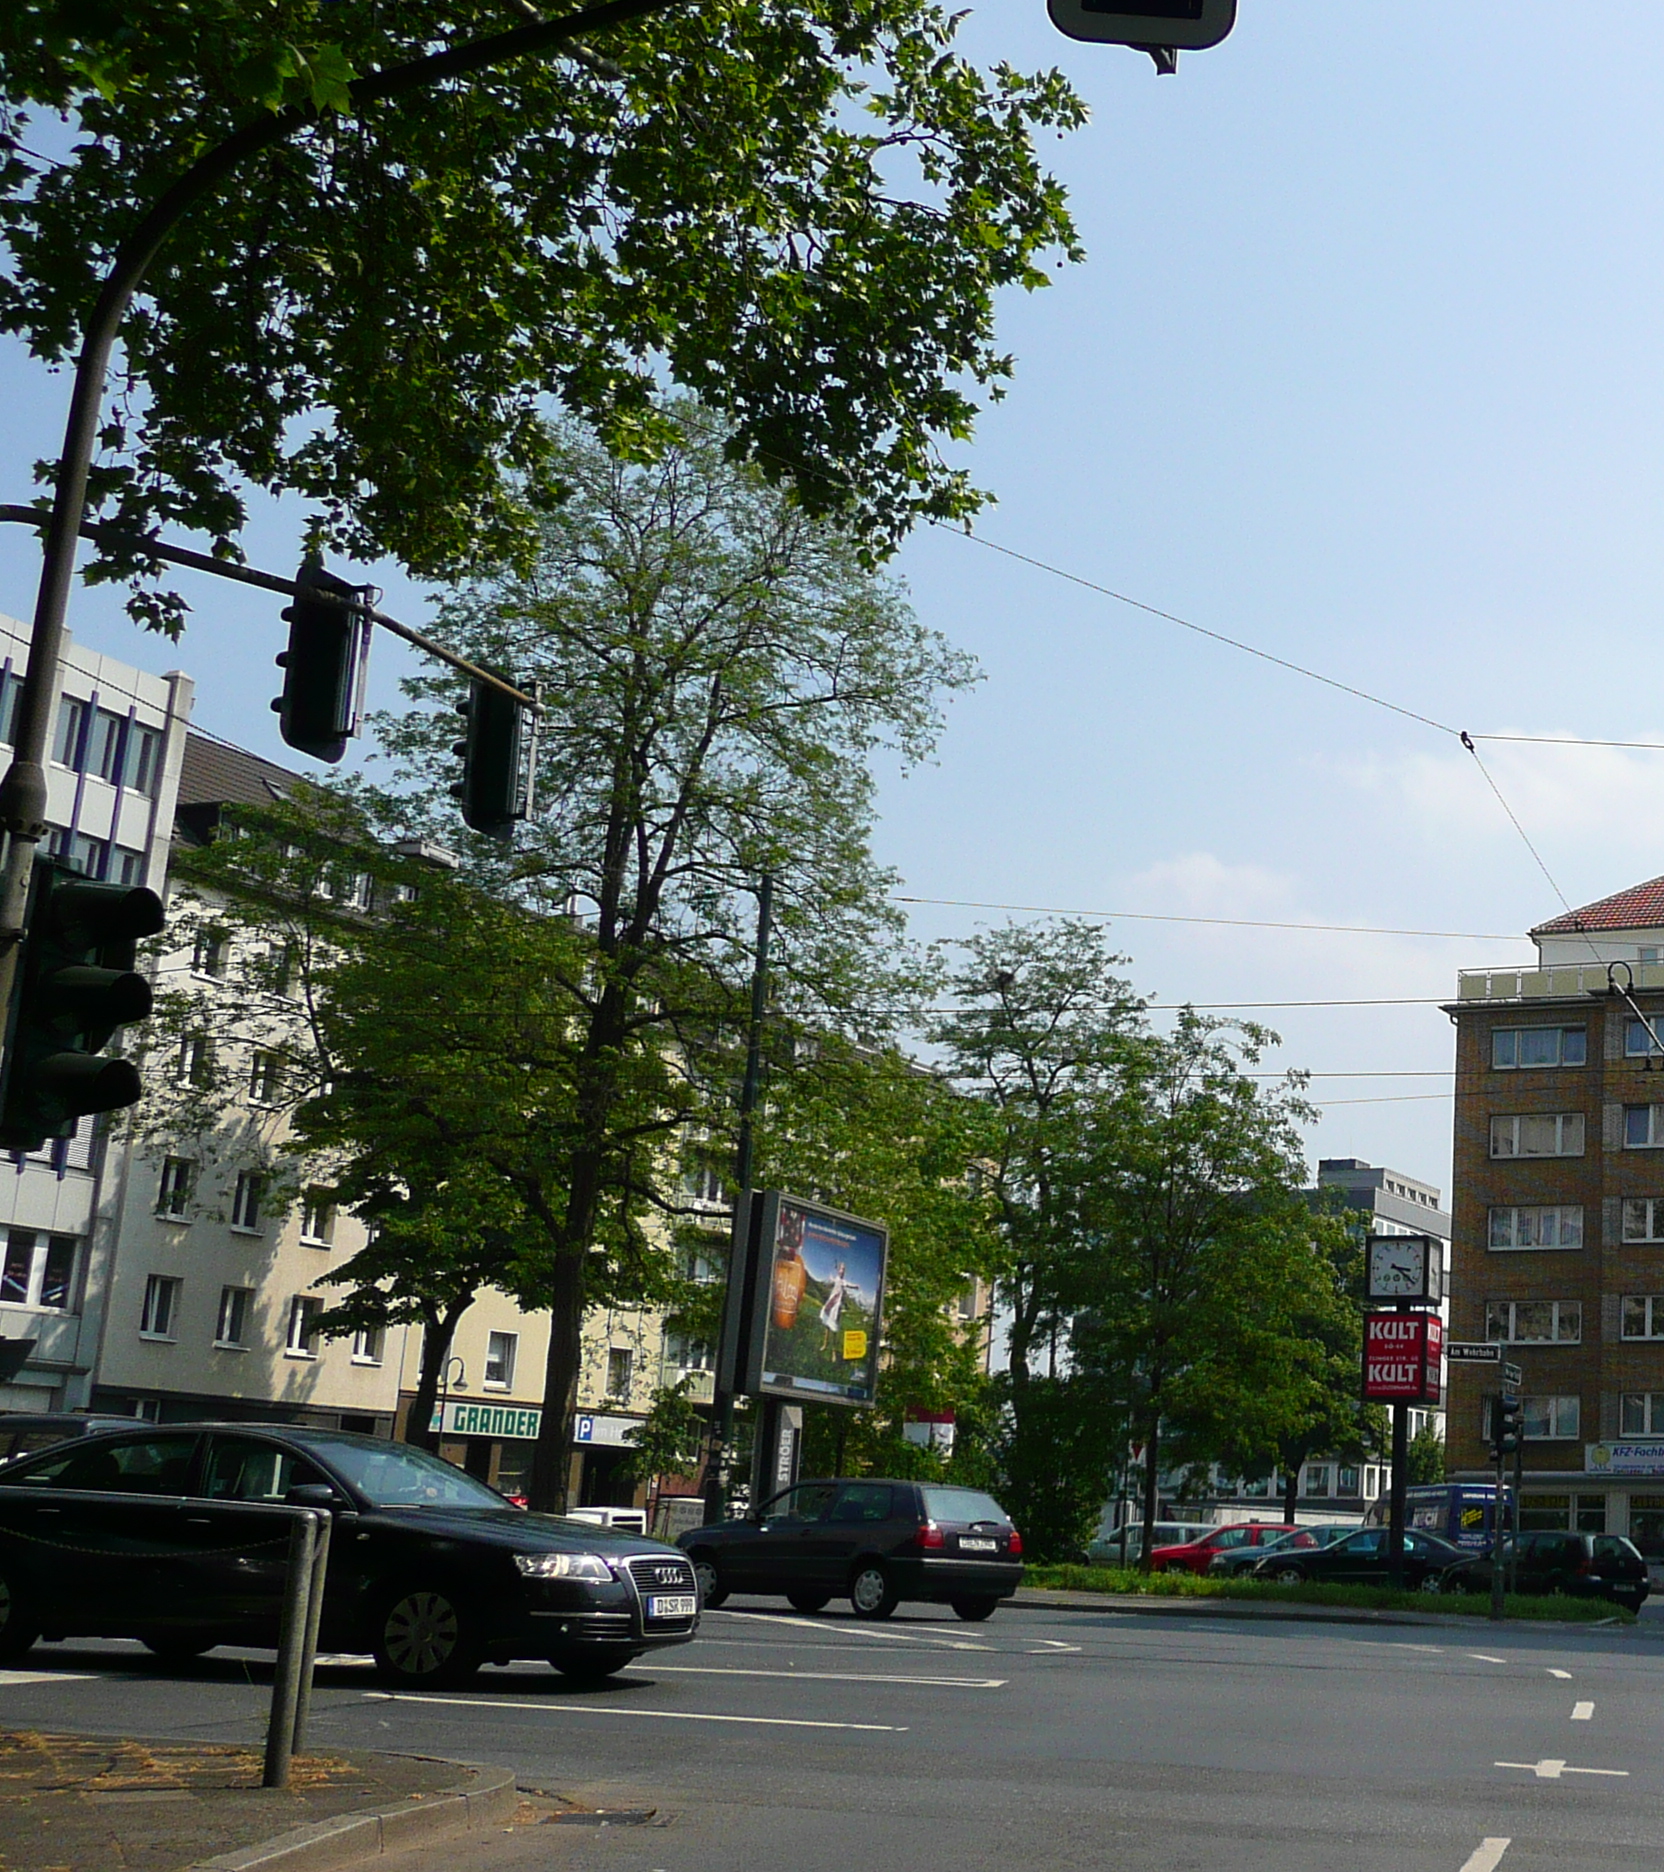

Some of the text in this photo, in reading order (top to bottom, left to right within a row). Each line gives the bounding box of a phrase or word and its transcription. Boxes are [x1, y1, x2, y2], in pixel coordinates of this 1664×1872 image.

[1370, 1321, 1419, 1340] KULT
[1450, 1346, 1495, 1358] Am Wehrhahn
[1368, 1364, 1418, 1382] KULT
[580, 1420, 591, 1438] P
[777, 1429, 792, 1481] STRÖER
[657, 1599, 664, 1613] D
